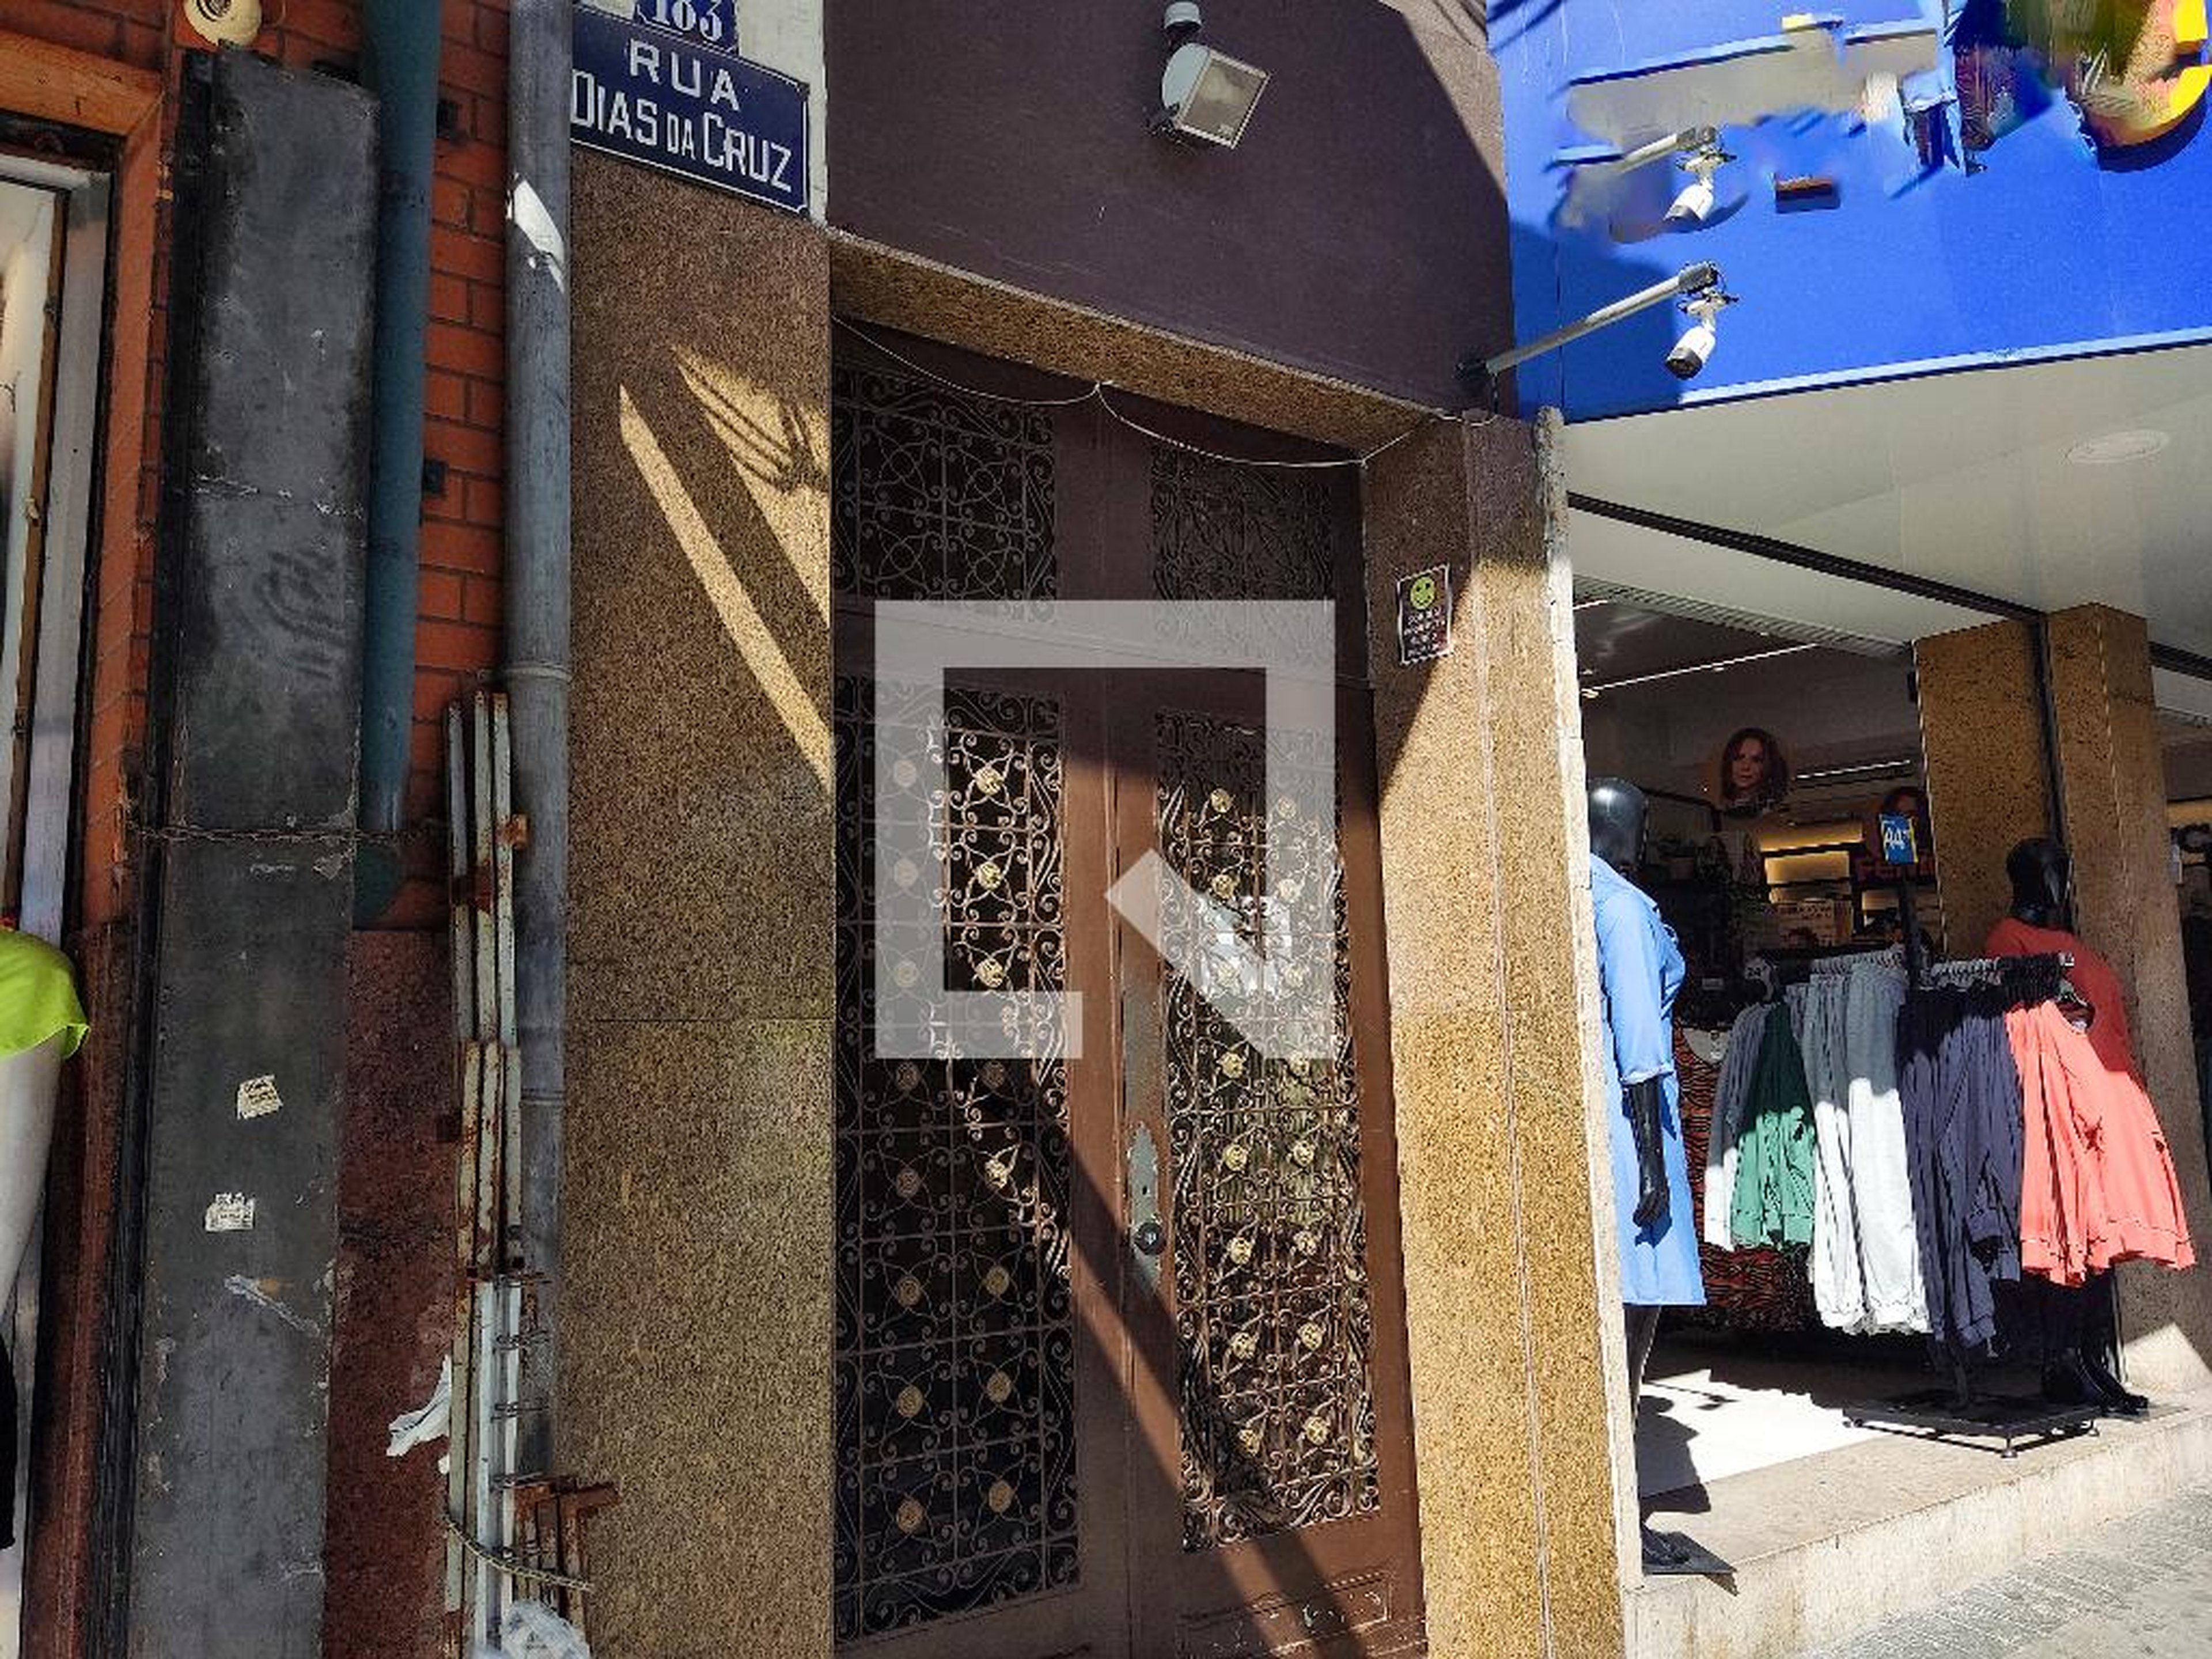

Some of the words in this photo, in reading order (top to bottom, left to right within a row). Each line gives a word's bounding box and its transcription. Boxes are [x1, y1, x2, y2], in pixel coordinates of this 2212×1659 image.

[630, 39, 740, 111] RUA
[571, 69, 657, 145] DIAS
[667, 112, 696, 160] DA
[703, 112, 791, 192] CRUZ
